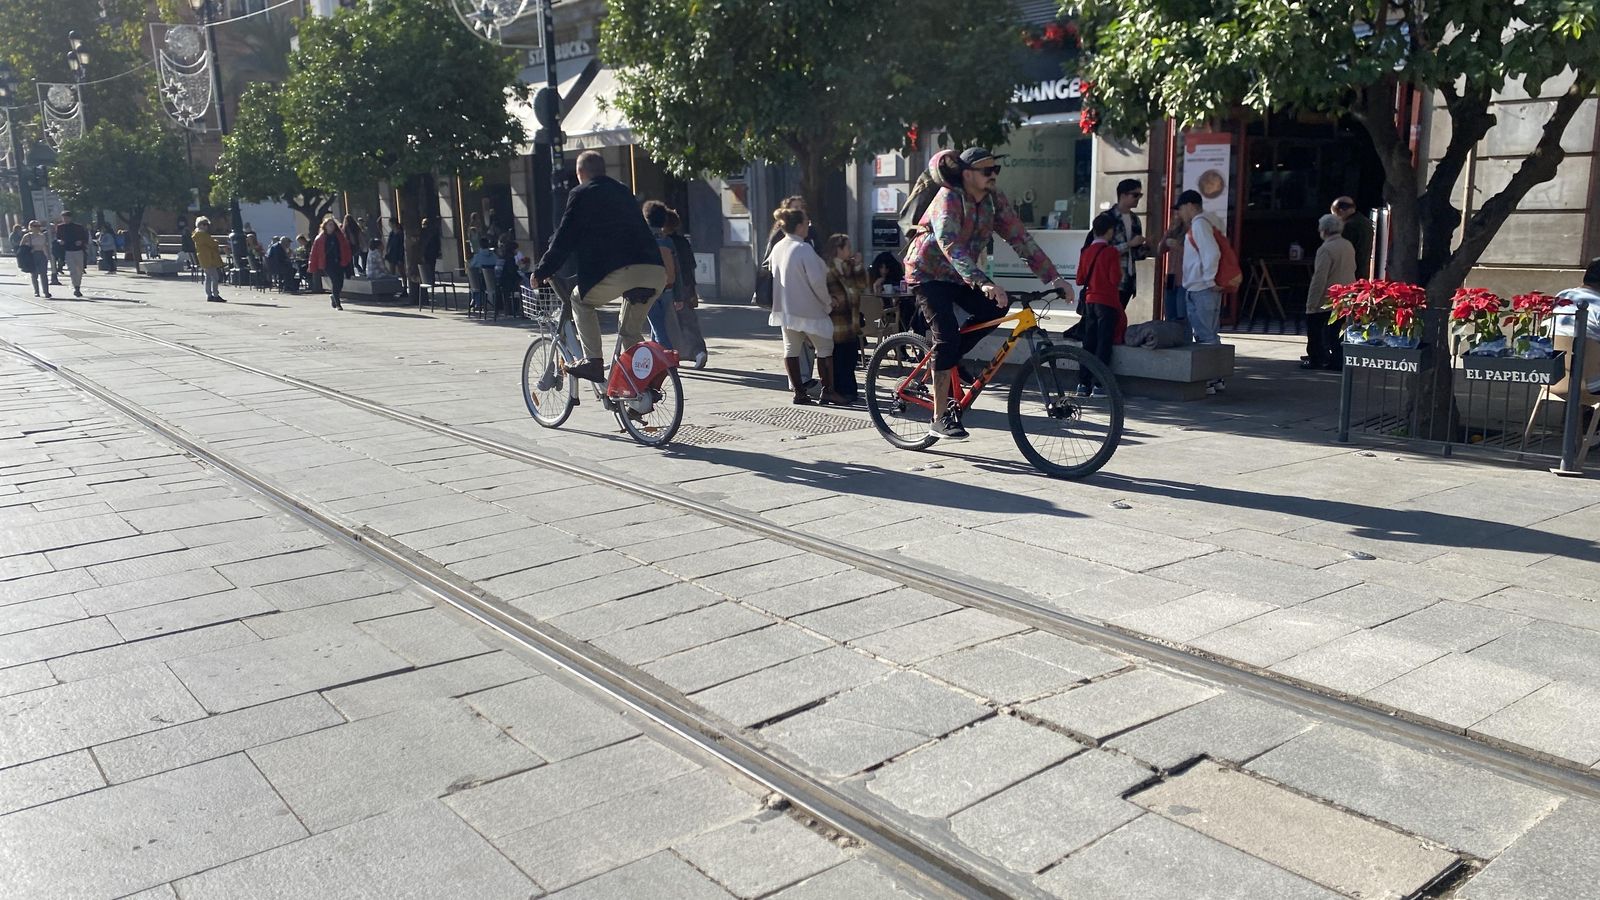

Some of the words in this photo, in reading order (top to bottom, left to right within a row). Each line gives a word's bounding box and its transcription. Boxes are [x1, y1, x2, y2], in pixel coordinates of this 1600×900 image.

[529, 40, 590, 66] STABUCKS
[1010, 77, 1081, 103] HANGE
[1345, 355, 1360, 367] EL
[1361, 357, 1419, 373] PAPELÓN
[1466, 368, 1483, 380] EL
[1485, 369, 1551, 384] PAPELÓN
